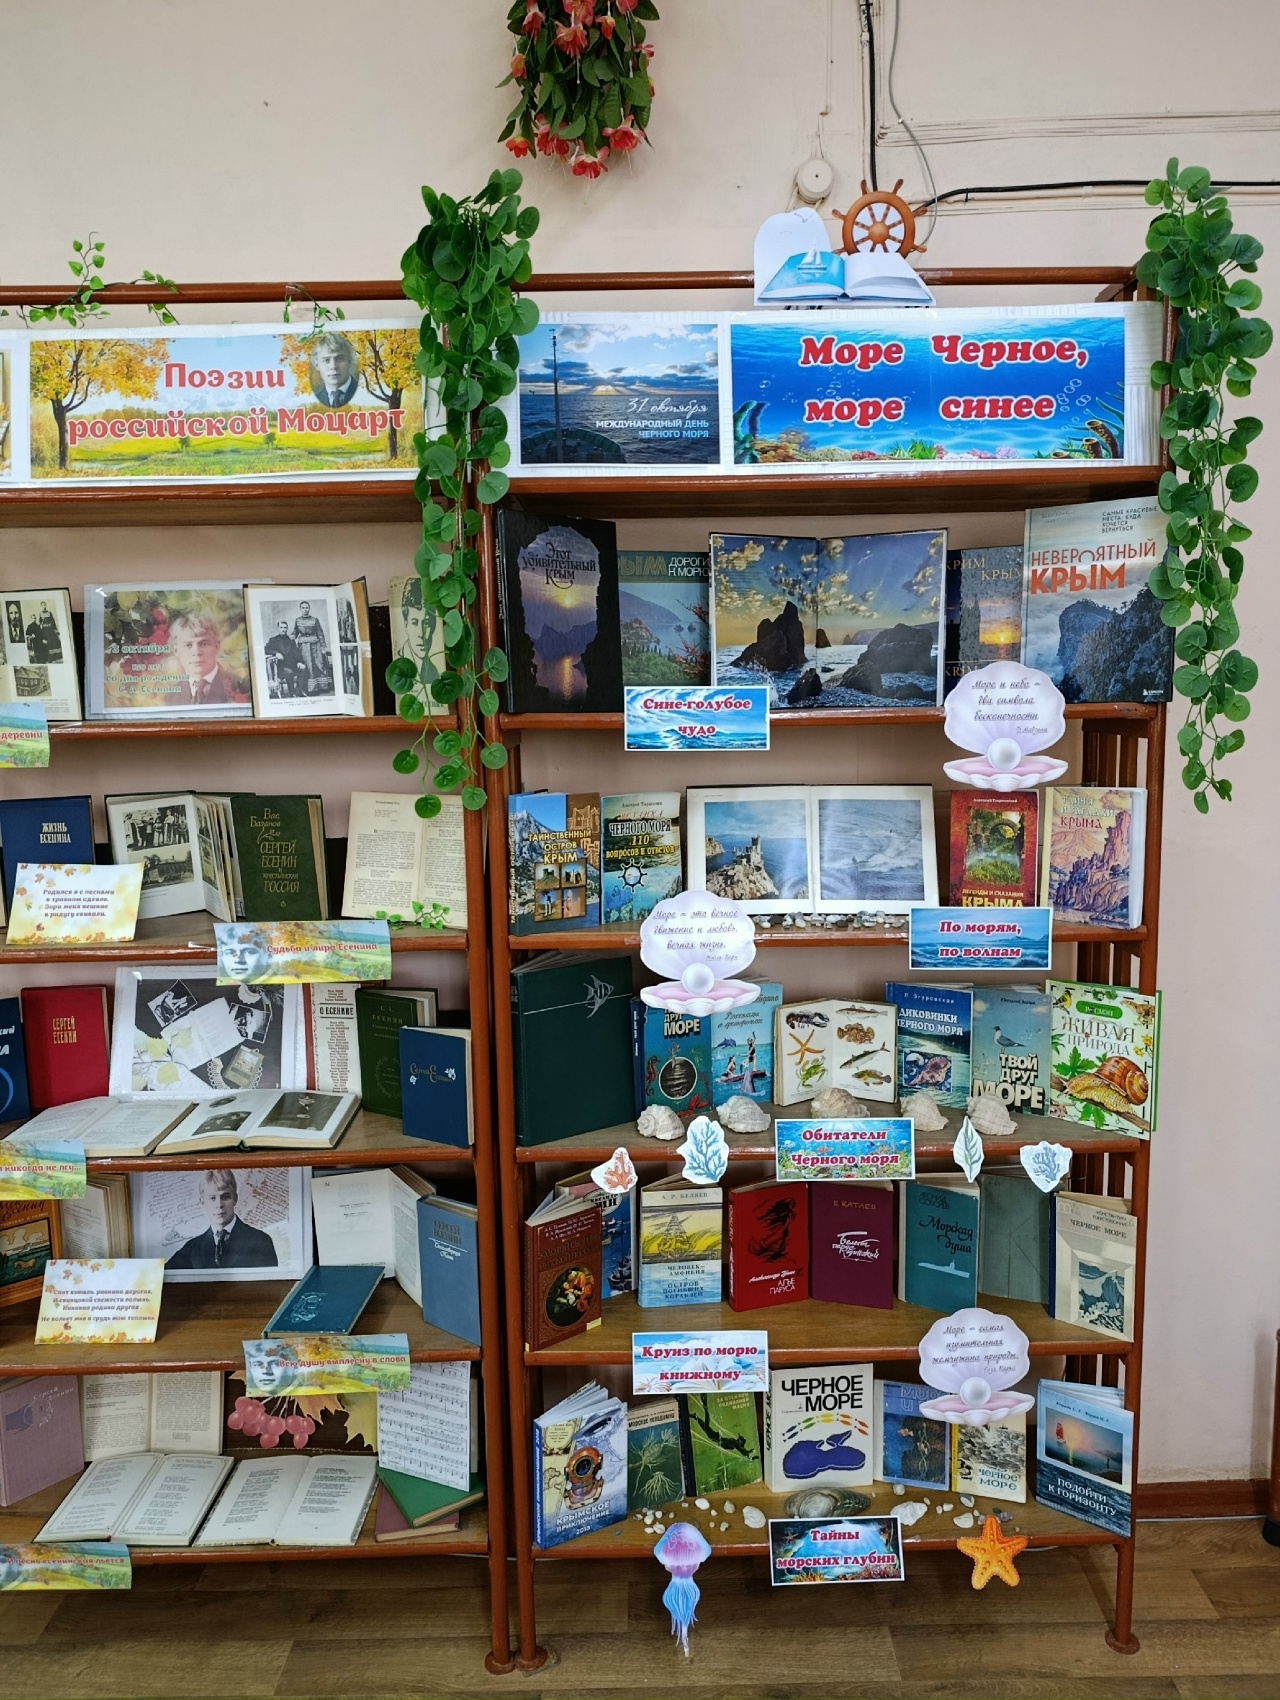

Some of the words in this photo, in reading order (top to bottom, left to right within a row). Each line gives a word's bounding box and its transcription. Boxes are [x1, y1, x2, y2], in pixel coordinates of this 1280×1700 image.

[800, 337, 902, 369] Море
[932, 336, 1088, 367] Черное,
[165, 362, 285, 389] Поэзии
[626, 398, 649, 412] 31
[651, 398, 708, 419] октября
[804, 399, 901, 426] море
[940, 396, 1055, 420] синее
[68, 407, 269, 445] российской
[277, 407, 406, 438] Моцарт
[596, 419, 682, 429] МЕЖДУНАРОДНЫЙ
[684, 420, 709, 428] ДЕНЬ
[638, 430, 680, 438] ЧЕРНОГО
[682, 430, 709, 438] МОРЯ
[1031, 538, 1156, 567] НЕВЕРОЯТНЫЙ
[1031, 562, 1125, 595] КРЫМ
[121, 643, 170, 655] октября
[972, 680, 996, 693] Море
[643, 696, 751, 711] Сине-голубое
[974, 710, 1038, 721] бесконечности
[2, 732, 43, 740] деревни
[678, 725, 716, 736] чудо
[41, 823, 67, 833] ЖИЗНЬ
[609, 820, 647, 836] ЧЕРНОГО
[649, 819, 671, 833] МОРЯ
[40, 834, 71, 844] ЕСЕНИНА
[528, 828, 592, 842] ТАИНСТВЕННЫЙ
[631, 835, 650, 846] 110
[260, 840, 297, 854] СЕРГЕЙ
[544, 841, 577, 852] ОСТРОВ
[262, 855, 297, 868] ЕСЕНИН
[544, 852, 578, 865] КРЫМ
[264, 881, 300, 893] РОССИЯ
[653, 910, 676, 923] Море
[940, 921, 961, 933] По
[965, 922, 1021, 935] морям,
[267, 945, 301, 954] Судьба
[312, 945, 336, 953] лира
[338, 943, 378, 951] Есенина
[667, 940, 695, 950] вечная
[940, 948, 959, 958] по
[963, 948, 1021, 958] волнам
[325, 1007, 354, 1015] ЕСЕНИНЕ
[899, 1008, 958, 1023] ДИКОВИНКИ
[53, 1016, 75, 1031] СЕРГЕЙ
[664, 1019, 700, 1036] МОРЕ
[936, 1024, 963, 1036] МОРЯ
[1061, 1015, 1135, 1043] ЖИВАЯ
[53, 1031, 77, 1044] ЕСЕНИН
[1068, 1034, 1130, 1056] ПРИРОДА
[999, 1053, 1038, 1070] ТВОЙ
[999, 1068, 1038, 1085] ДРУГ
[972, 1079, 1044, 1110] МОРЕ
[802, 1128, 887, 1141] Обитатели
[791, 1154, 856, 1166] Черного
[860, 1155, 899, 1166] моря
[841, 1200, 876, 1210] КАТАЕВ
[919, 1215, 973, 1241] Морская
[1070, 1219, 1101, 1232] ЧЕРНОЕ
[1104, 1227, 1127, 1239] МОРЕ
[937, 1234, 972, 1255] душа
[943, 1326, 965, 1337] Море
[641, 1346, 690, 1359] Круиз
[694, 1347, 712, 1356] по
[715, 1346, 758, 1358] морю
[300, 1360, 324, 1368] душу
[327, 1358, 370, 1366] выплесну
[659, 1370, 742, 1382] книжному
[782, 1375, 864, 1397] ЧЕРНОЕ
[805, 1392, 863, 1412] МОРЕ
[980, 1478, 1017, 1490] МОРЕ
[1057, 1478, 1107, 1503] ПОДОЙТИ
[1048, 1484, 1055, 1493] К
[1057, 1488, 1117, 1516] ГОРИЗОНТУ
[556, 1501, 610, 1526] КРЫМСКОЕ
[557, 1509, 610, 1533] ПРИКЛЮЧЕНИЕ
[810, 1529, 859, 1542] Тайны
[777, 1557, 840, 1569] морских
[843, 1552, 896, 1566] глубин
